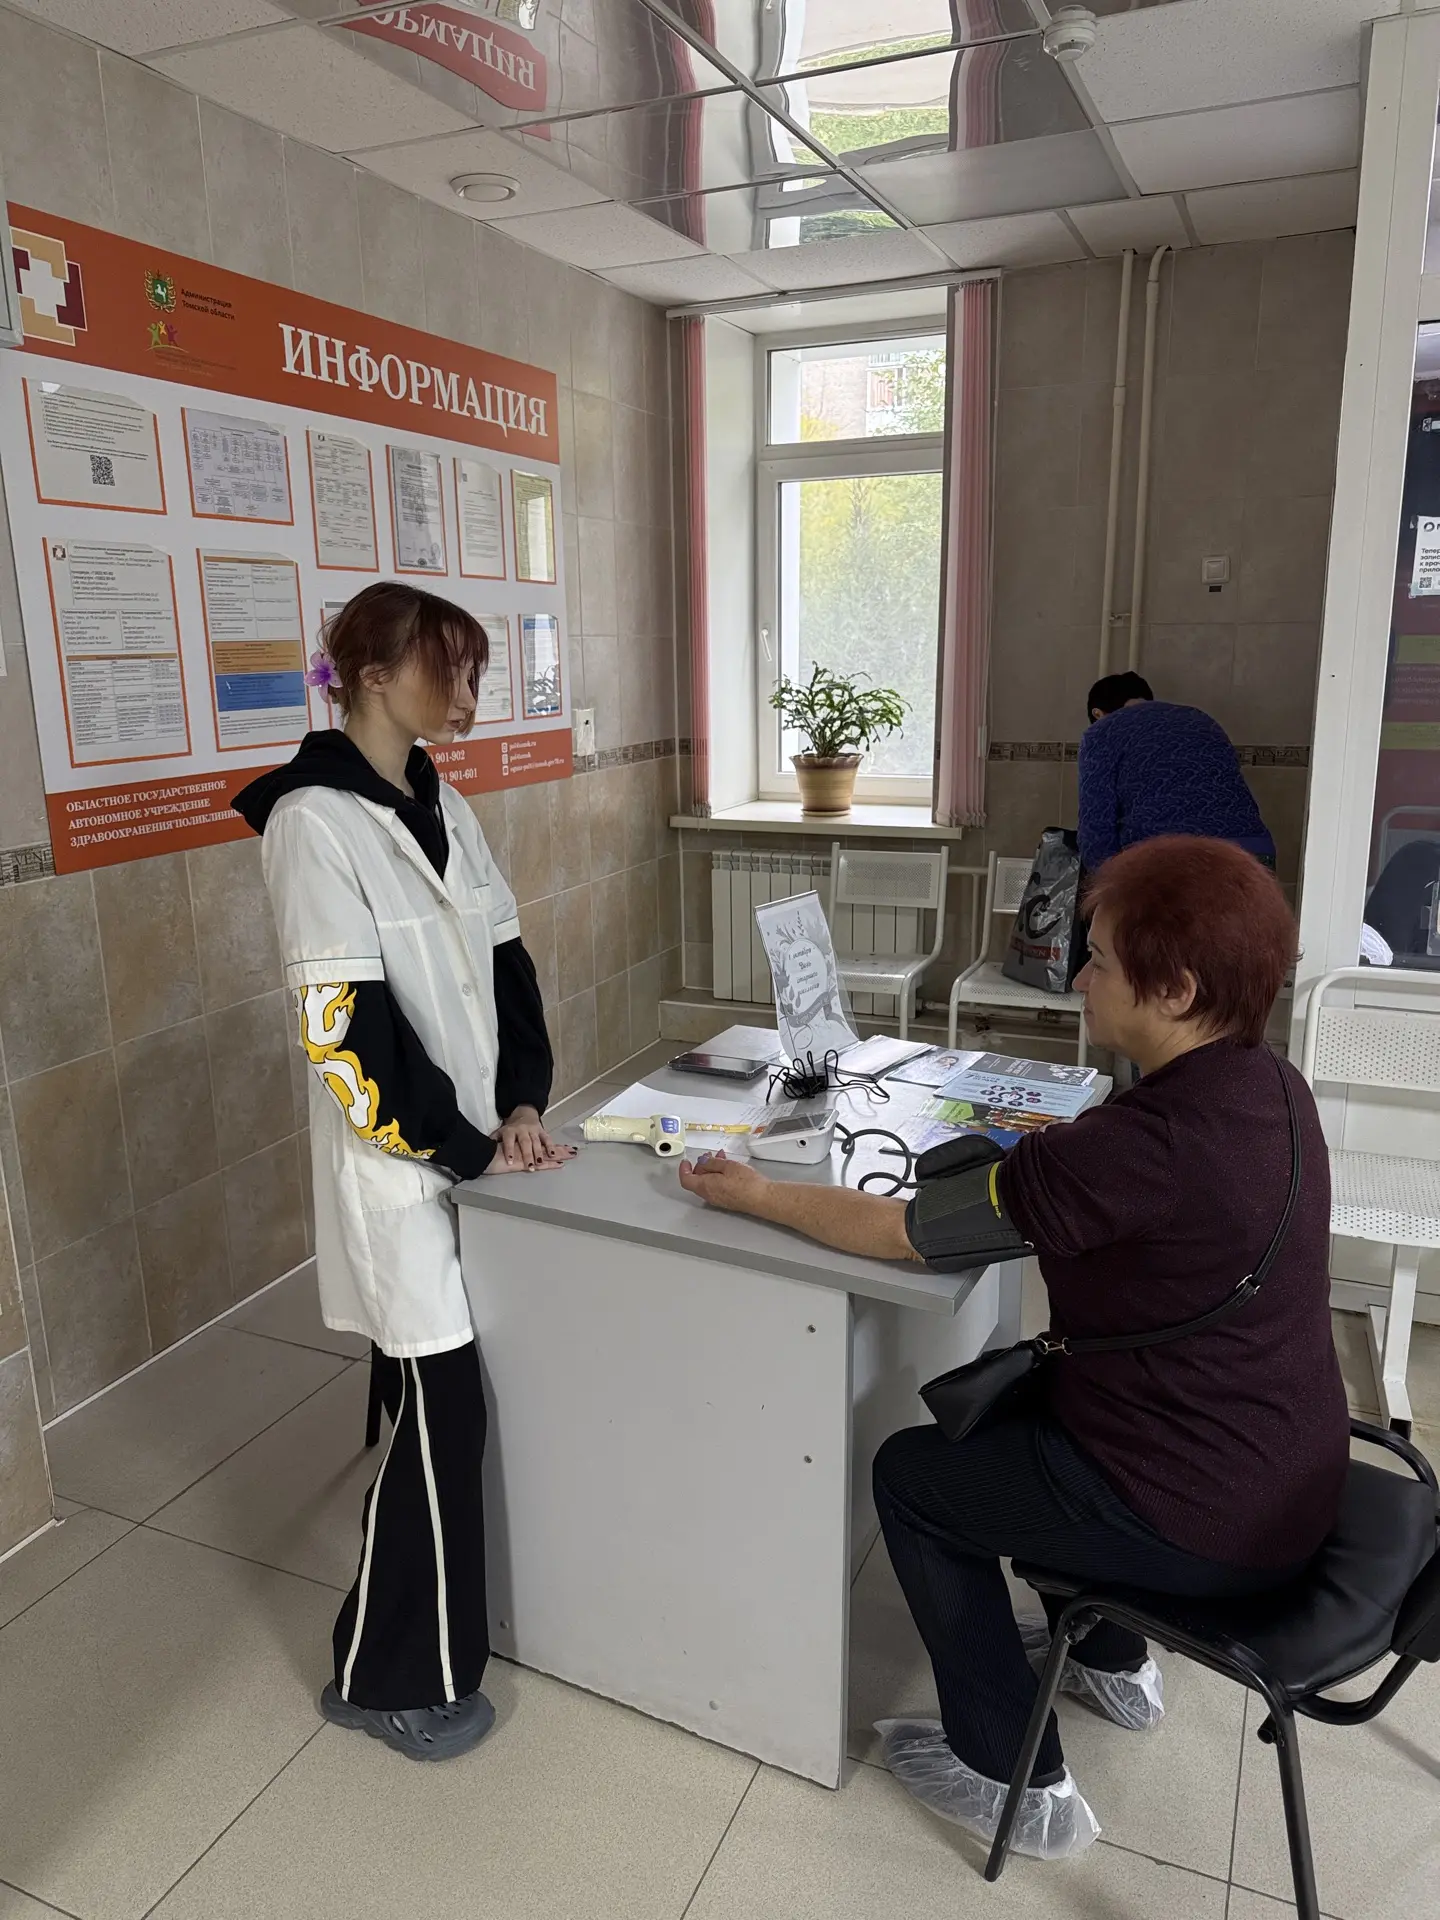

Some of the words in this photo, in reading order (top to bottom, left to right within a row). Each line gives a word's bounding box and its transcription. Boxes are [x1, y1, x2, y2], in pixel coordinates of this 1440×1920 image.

[181, 288, 232, 308] Администрация
[182, 299, 210, 313] Томской
[210, 307, 236, 320] области
[278, 322, 549, 438] ИНФОРМАЦИЯ
[435, 749, 466, 764] 901-902
[449, 768, 478, 782] 901-601
[66, 794, 132, 813] ОБЛАСТНОЕ
[132, 780, 227, 803] ГОСУДАРСТВЕННОЕ
[68, 808, 143, 830] АВТОНОМНОЕ
[143, 798, 211, 818] УЧРЕЖДЕНИЕ
[70, 821, 172, 848] ЗДРАВООХРАНЕНИЯ
